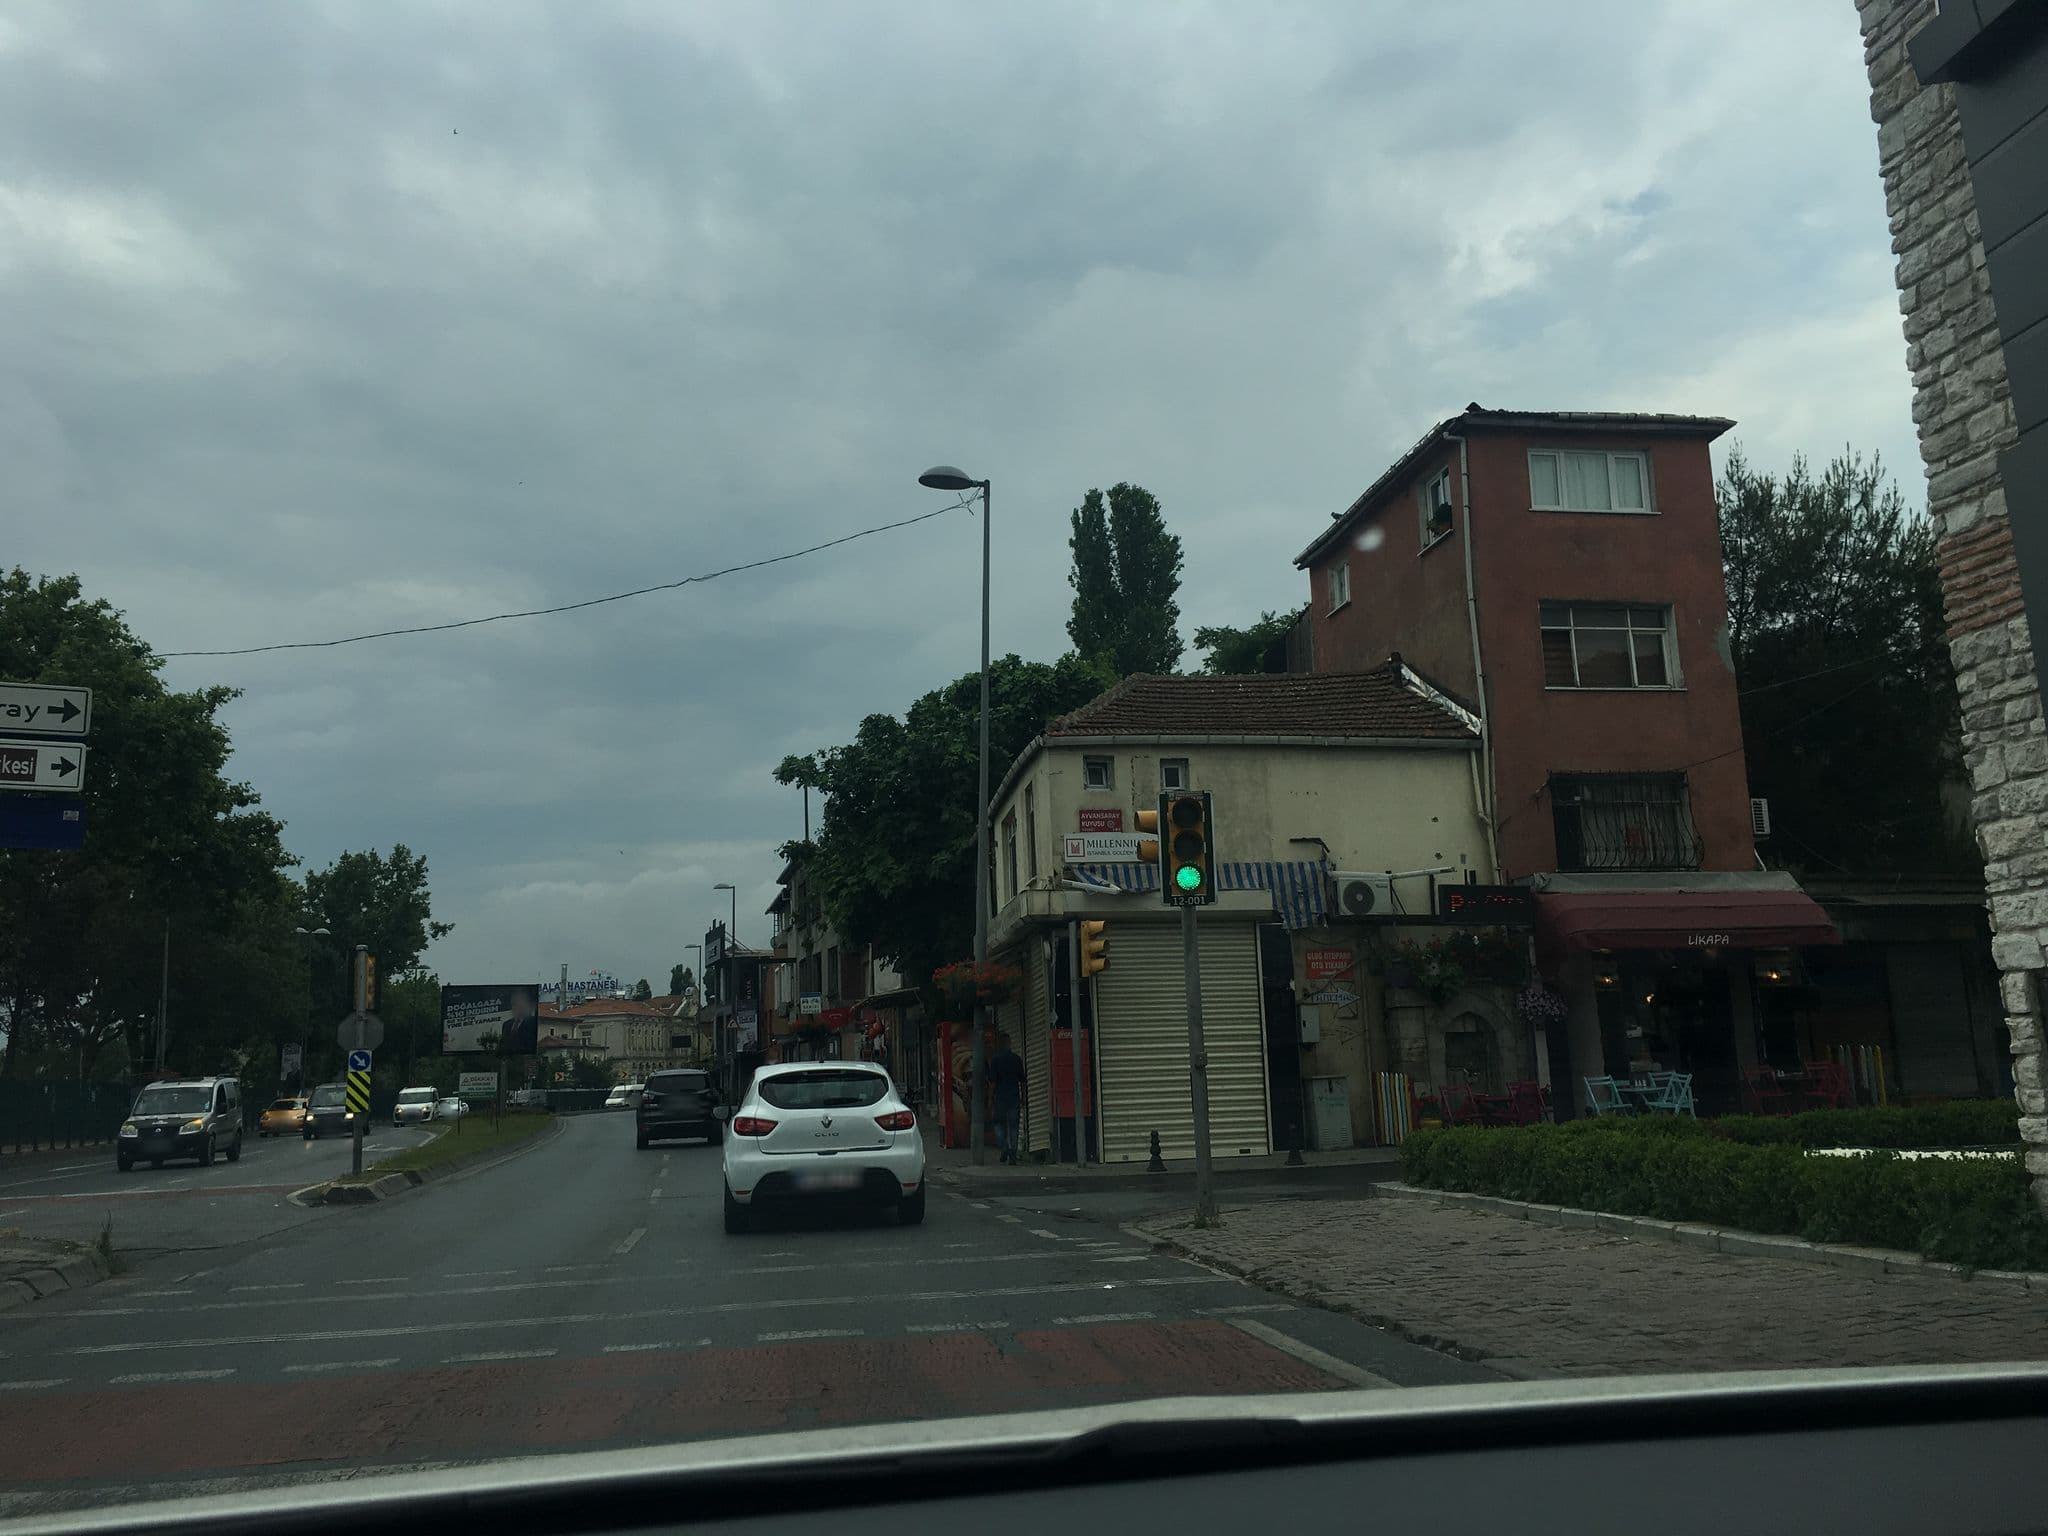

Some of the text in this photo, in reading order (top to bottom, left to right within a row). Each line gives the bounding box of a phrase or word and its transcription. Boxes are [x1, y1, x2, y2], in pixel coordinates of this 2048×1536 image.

[0, 754, 34, 775] kesi
[1080, 812, 1120, 820] AYVANSARAY
[1172, 896, 1205, 906] 12-001
